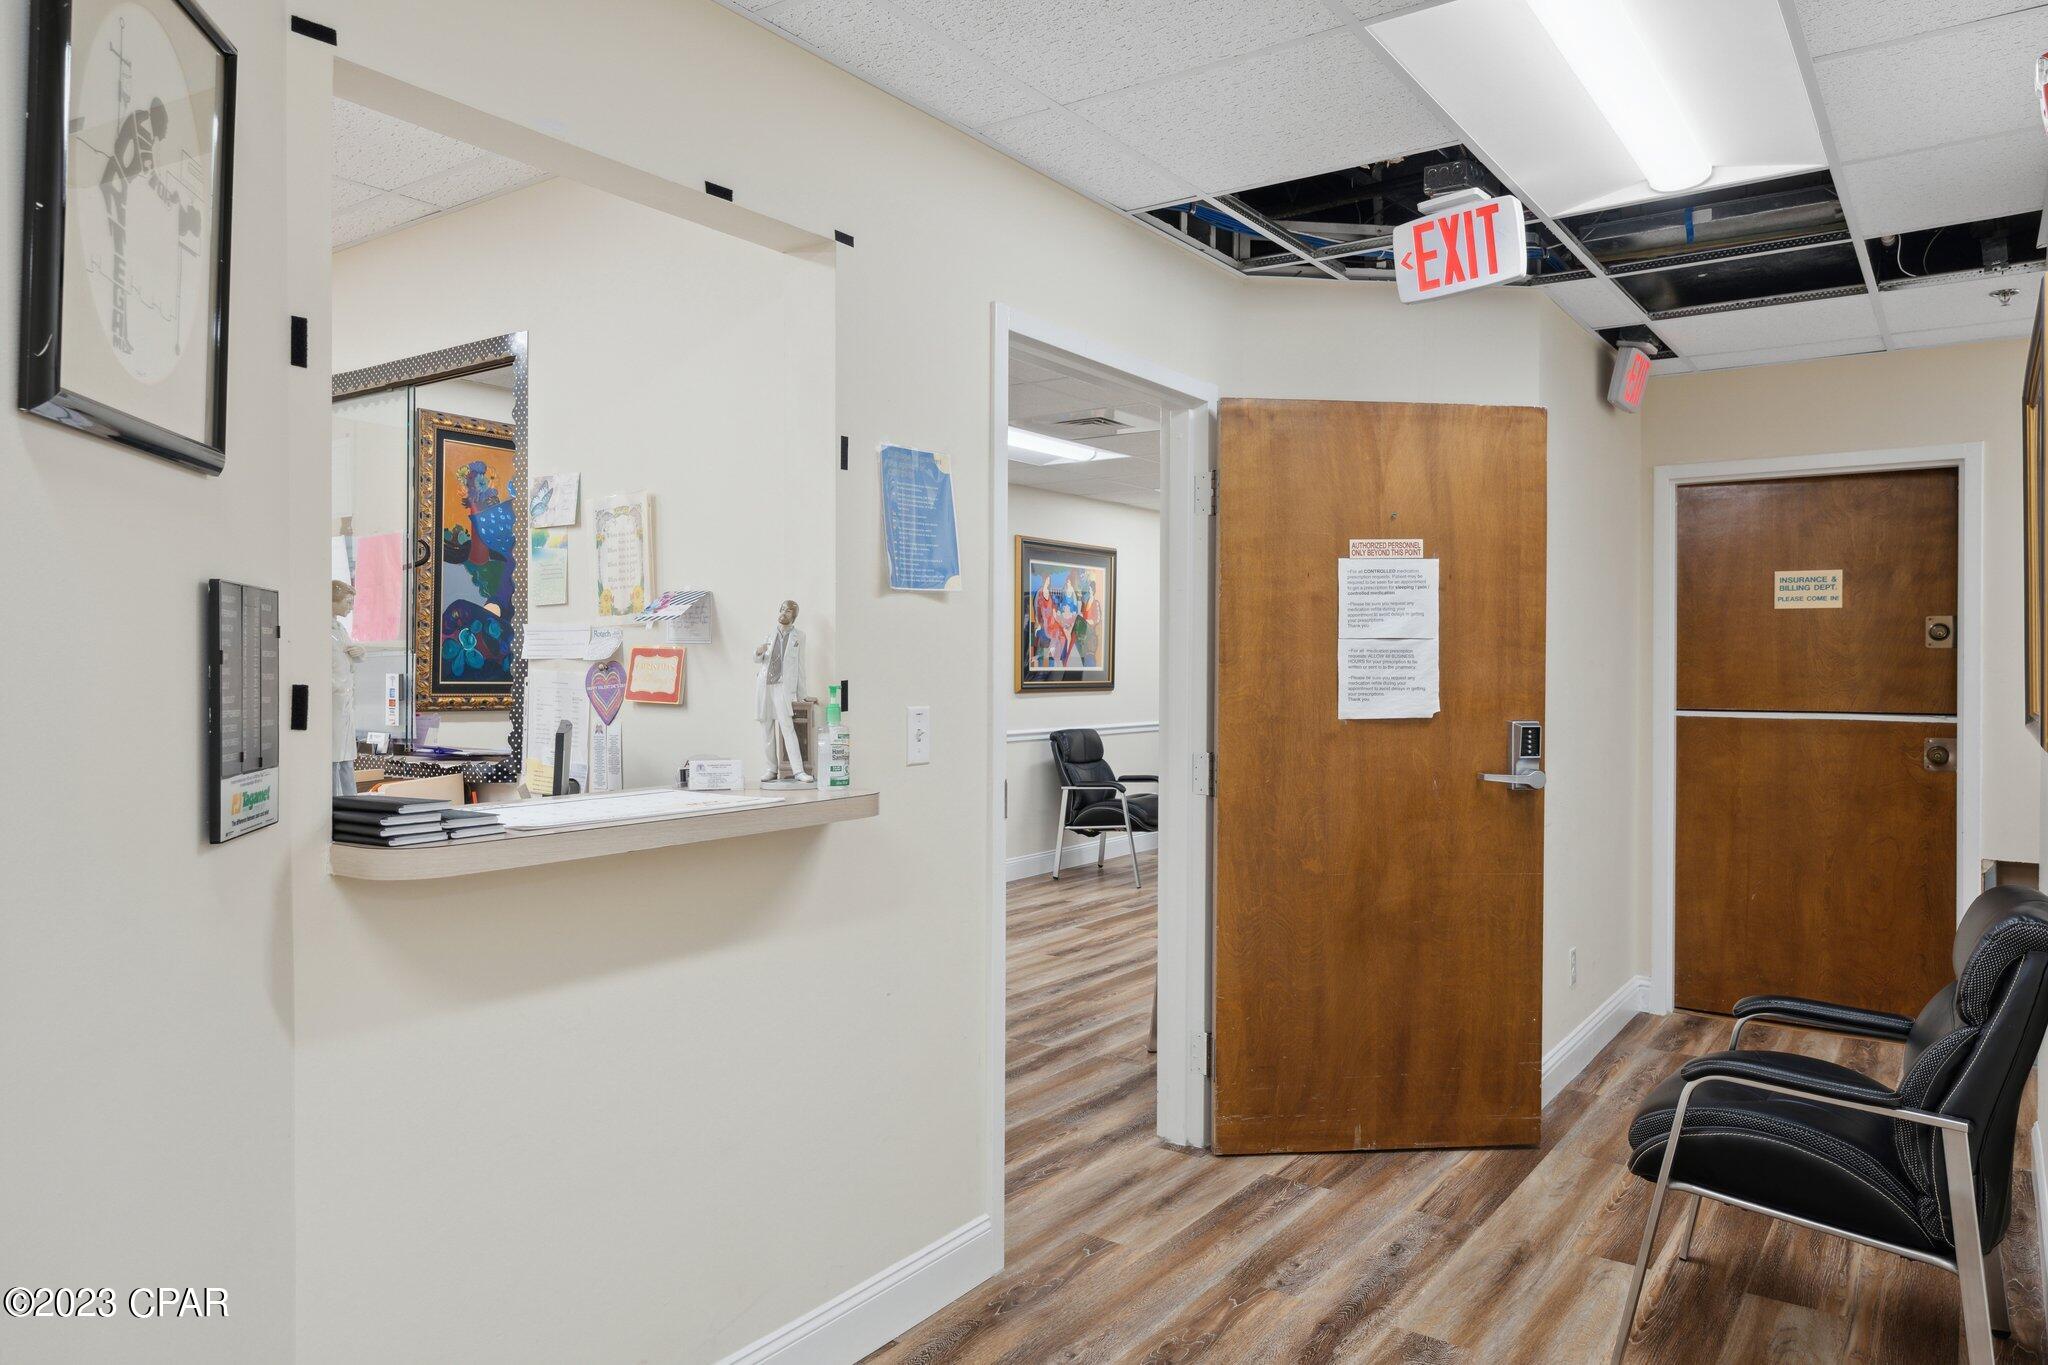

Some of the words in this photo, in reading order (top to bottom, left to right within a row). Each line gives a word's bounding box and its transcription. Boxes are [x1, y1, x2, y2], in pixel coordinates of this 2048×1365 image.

[1412, 203, 1500, 292] EXIT
[1351, 541, 1387, 549] AUTHORIZED
[1388, 541, 1421, 549] PERSONNEL
[1351, 549, 1366, 557] ONLY
[1779, 576, 1828, 584] INSURANCE
[1779, 584, 1811, 592] BILLING
[1814, 583, 1838, 591] DEPT.
